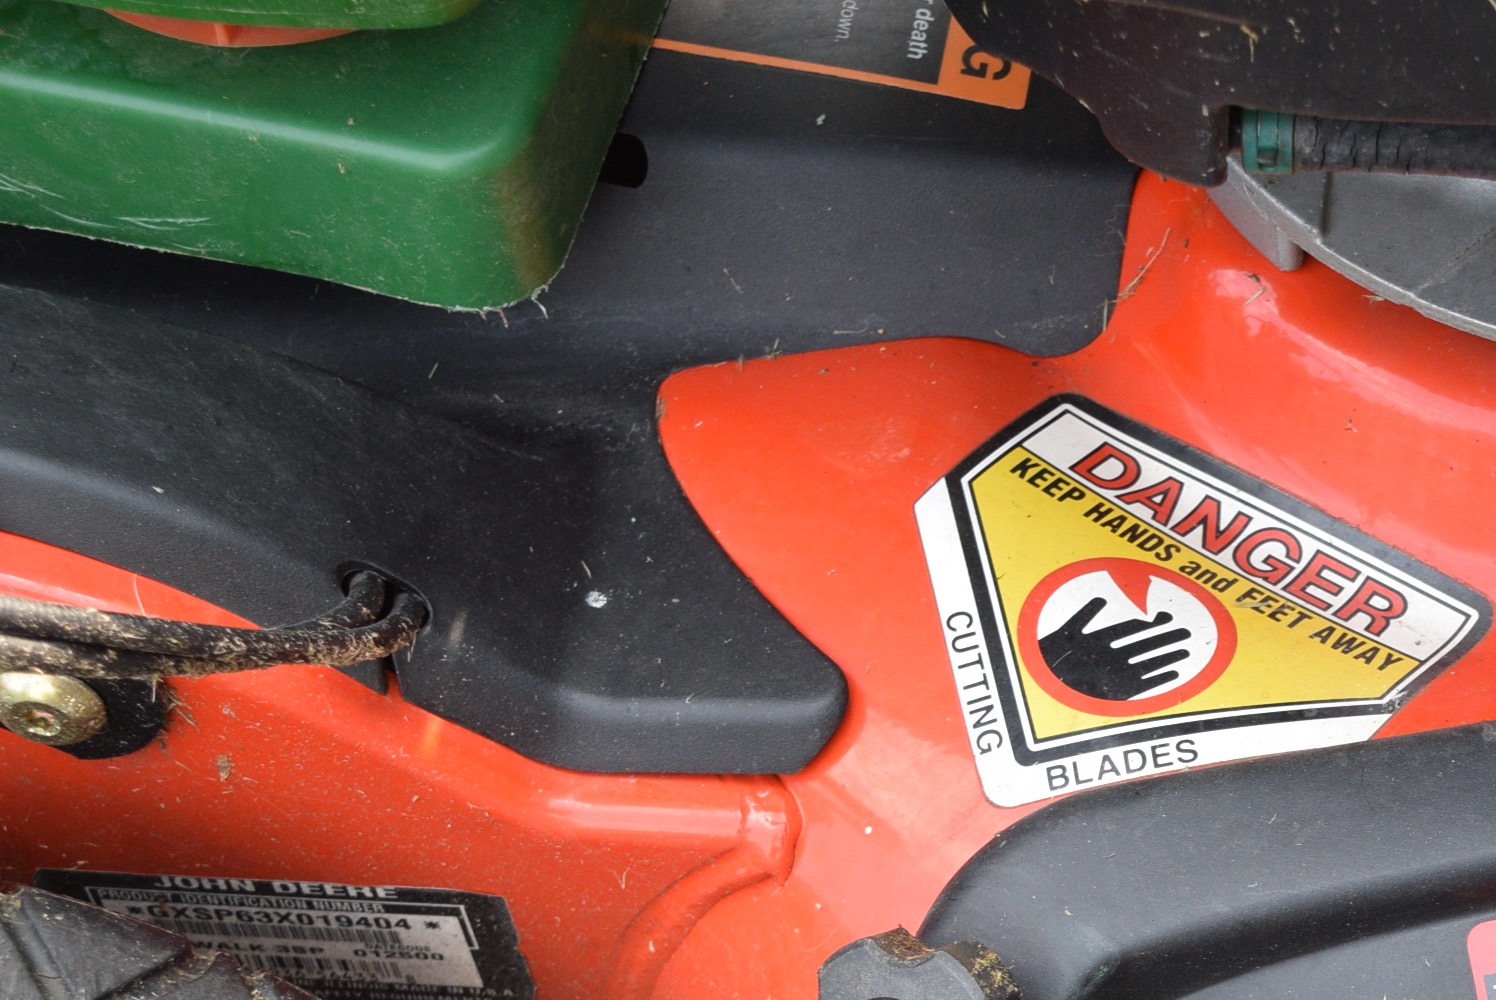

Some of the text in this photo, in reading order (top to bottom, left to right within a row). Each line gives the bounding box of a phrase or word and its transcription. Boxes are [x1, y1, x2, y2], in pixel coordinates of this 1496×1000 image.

[907, 8, 934, 60] death
[1010, 457, 1404, 671] KEEP HANDS and FEET AWAY
[1068, 441, 1408, 637] DANGER
[945, 610, 1002, 757] CUTTING
[1046, 739, 1199, 791] BLADES
[99, 889, 385, 913] PRODUCT IDENTIFICATION NUMBER
[154, 876, 399, 899] JOHN DEERE
